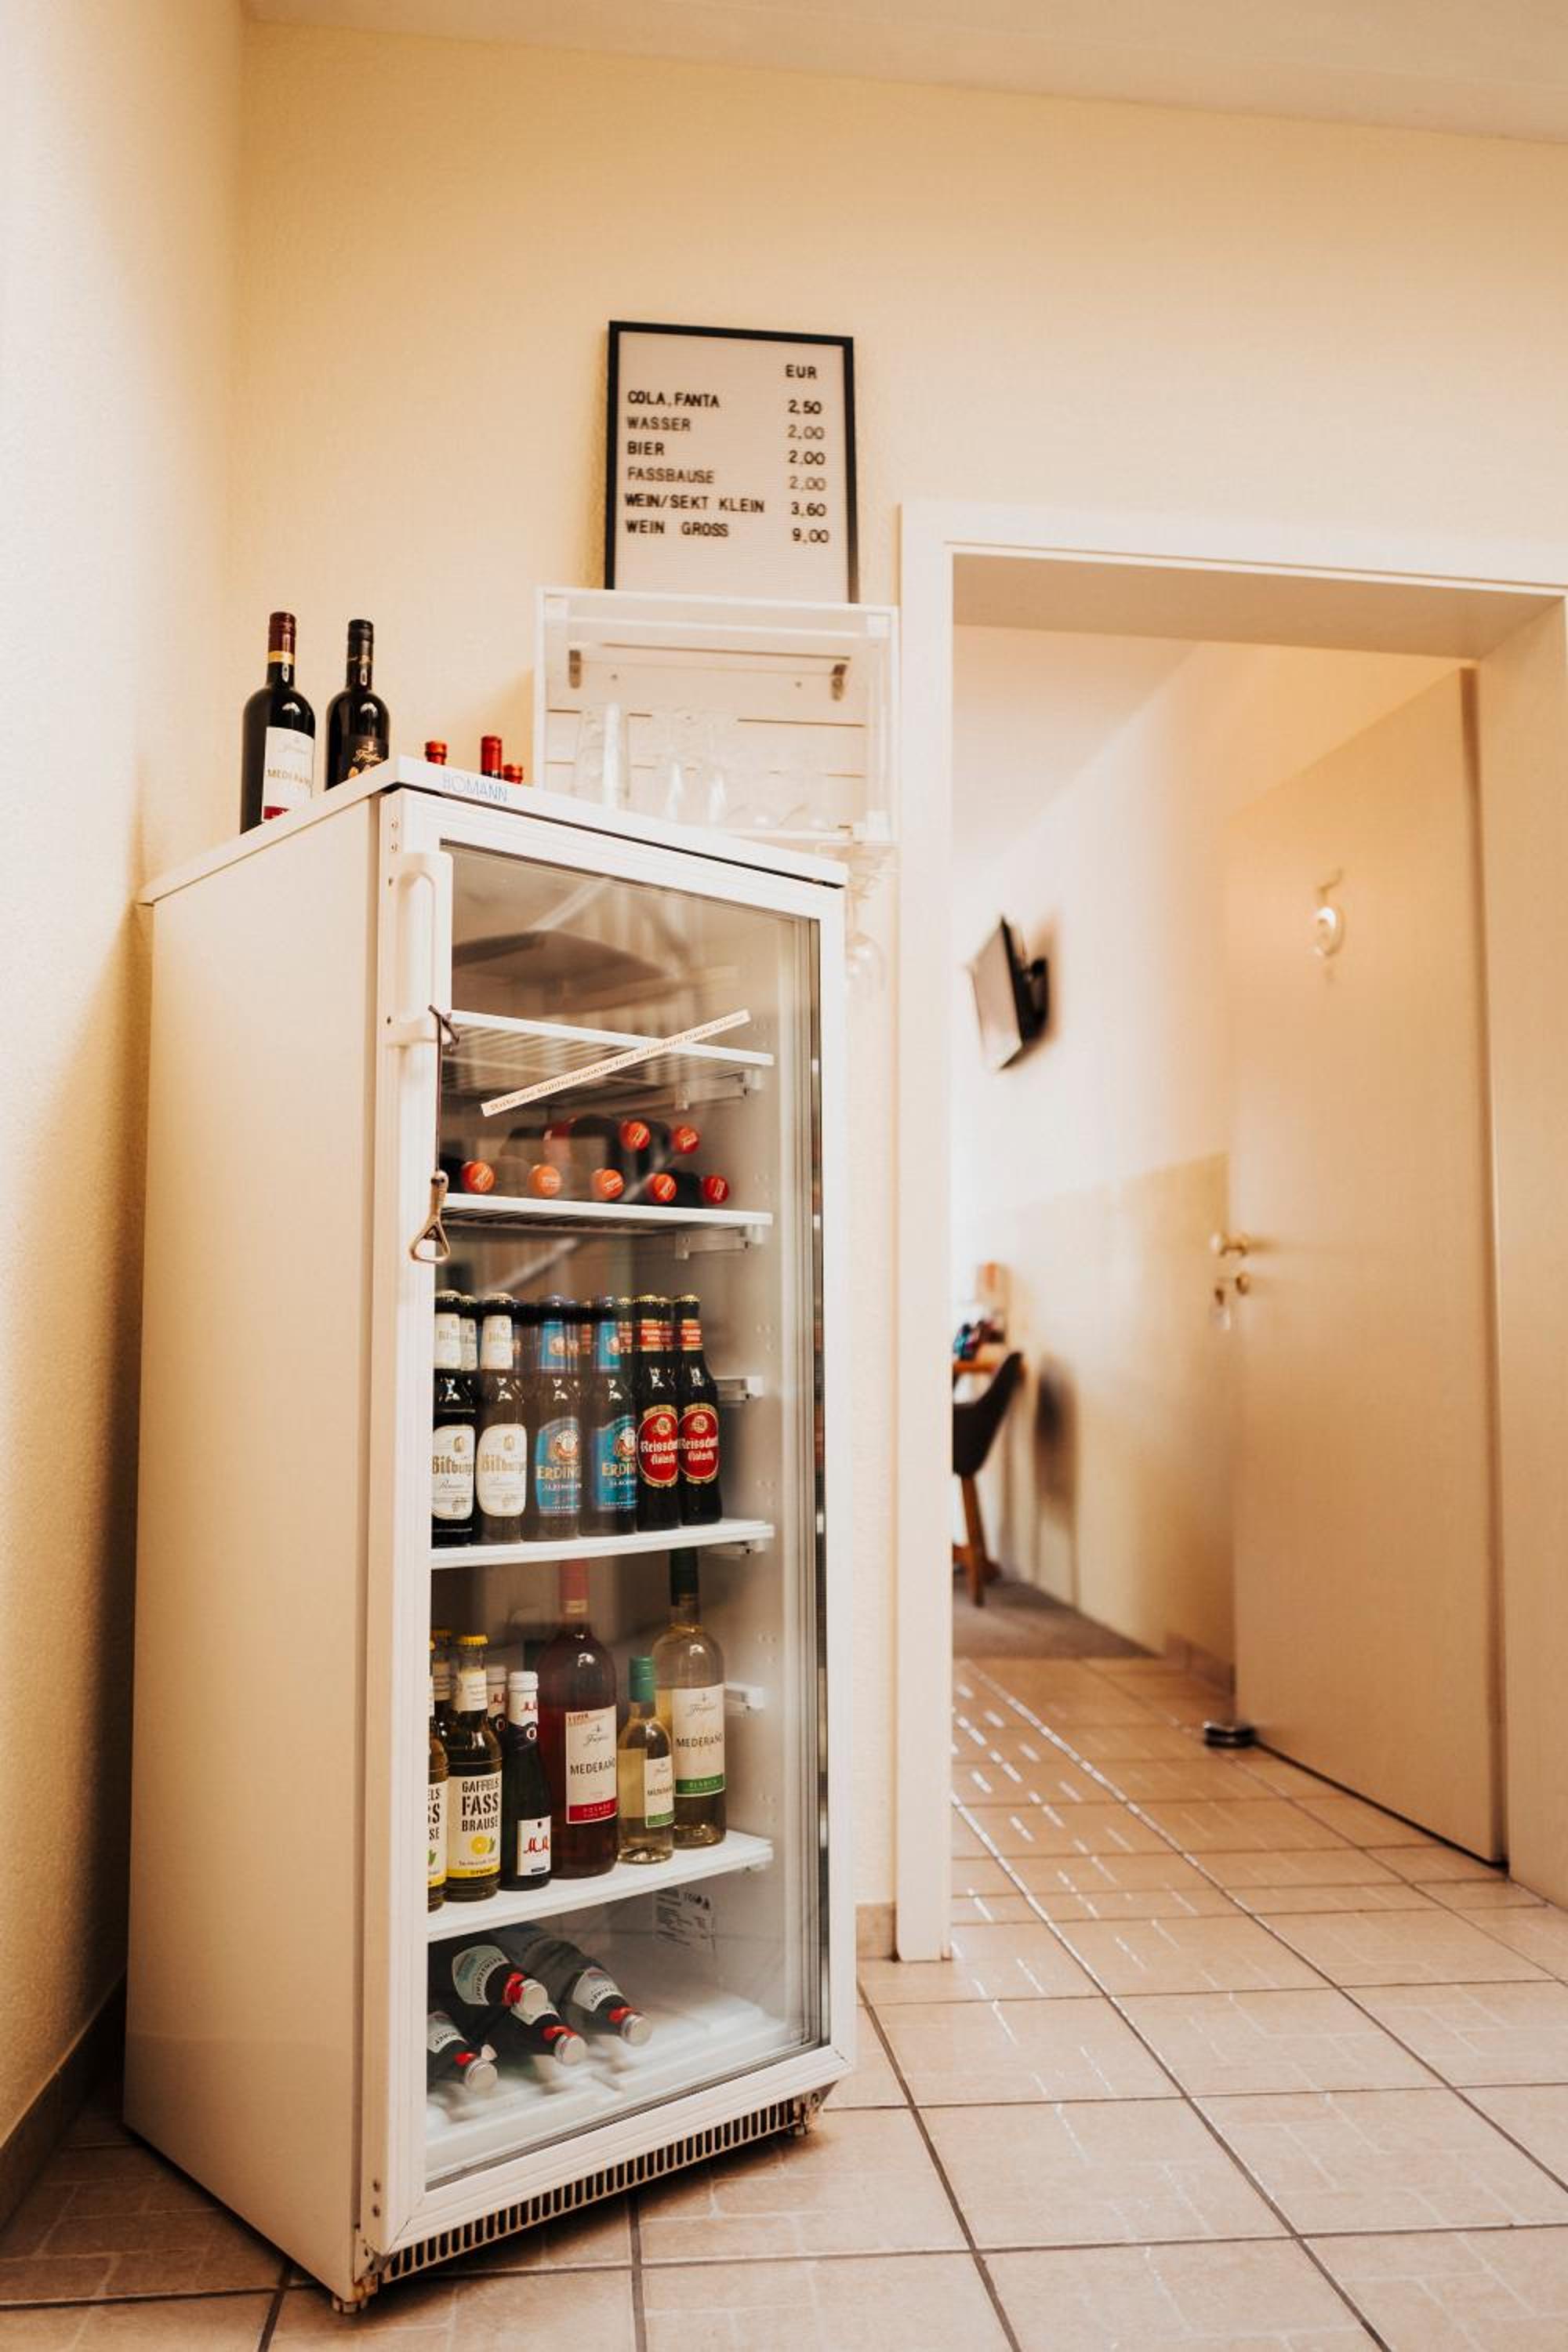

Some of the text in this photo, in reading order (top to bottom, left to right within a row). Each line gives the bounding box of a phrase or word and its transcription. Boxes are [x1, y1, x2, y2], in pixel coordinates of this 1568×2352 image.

[786, 365, 817, 379] EUR
[627, 416, 691, 432] WASSER
[627, 441, 665, 456] BIER
[627, 466, 716, 484] FASSBAUSE
[625, 493, 710, 510] WEIN/SEKT
[719, 498, 765, 513] KLEIN
[626, 520, 665, 534] WEIN
[681, 521, 729, 537] GROSS
[462, 1778, 499, 1793] GAFFELS
[462, 1792, 499, 1816] FASS
[462, 1815, 499, 1831] BRAUSE
